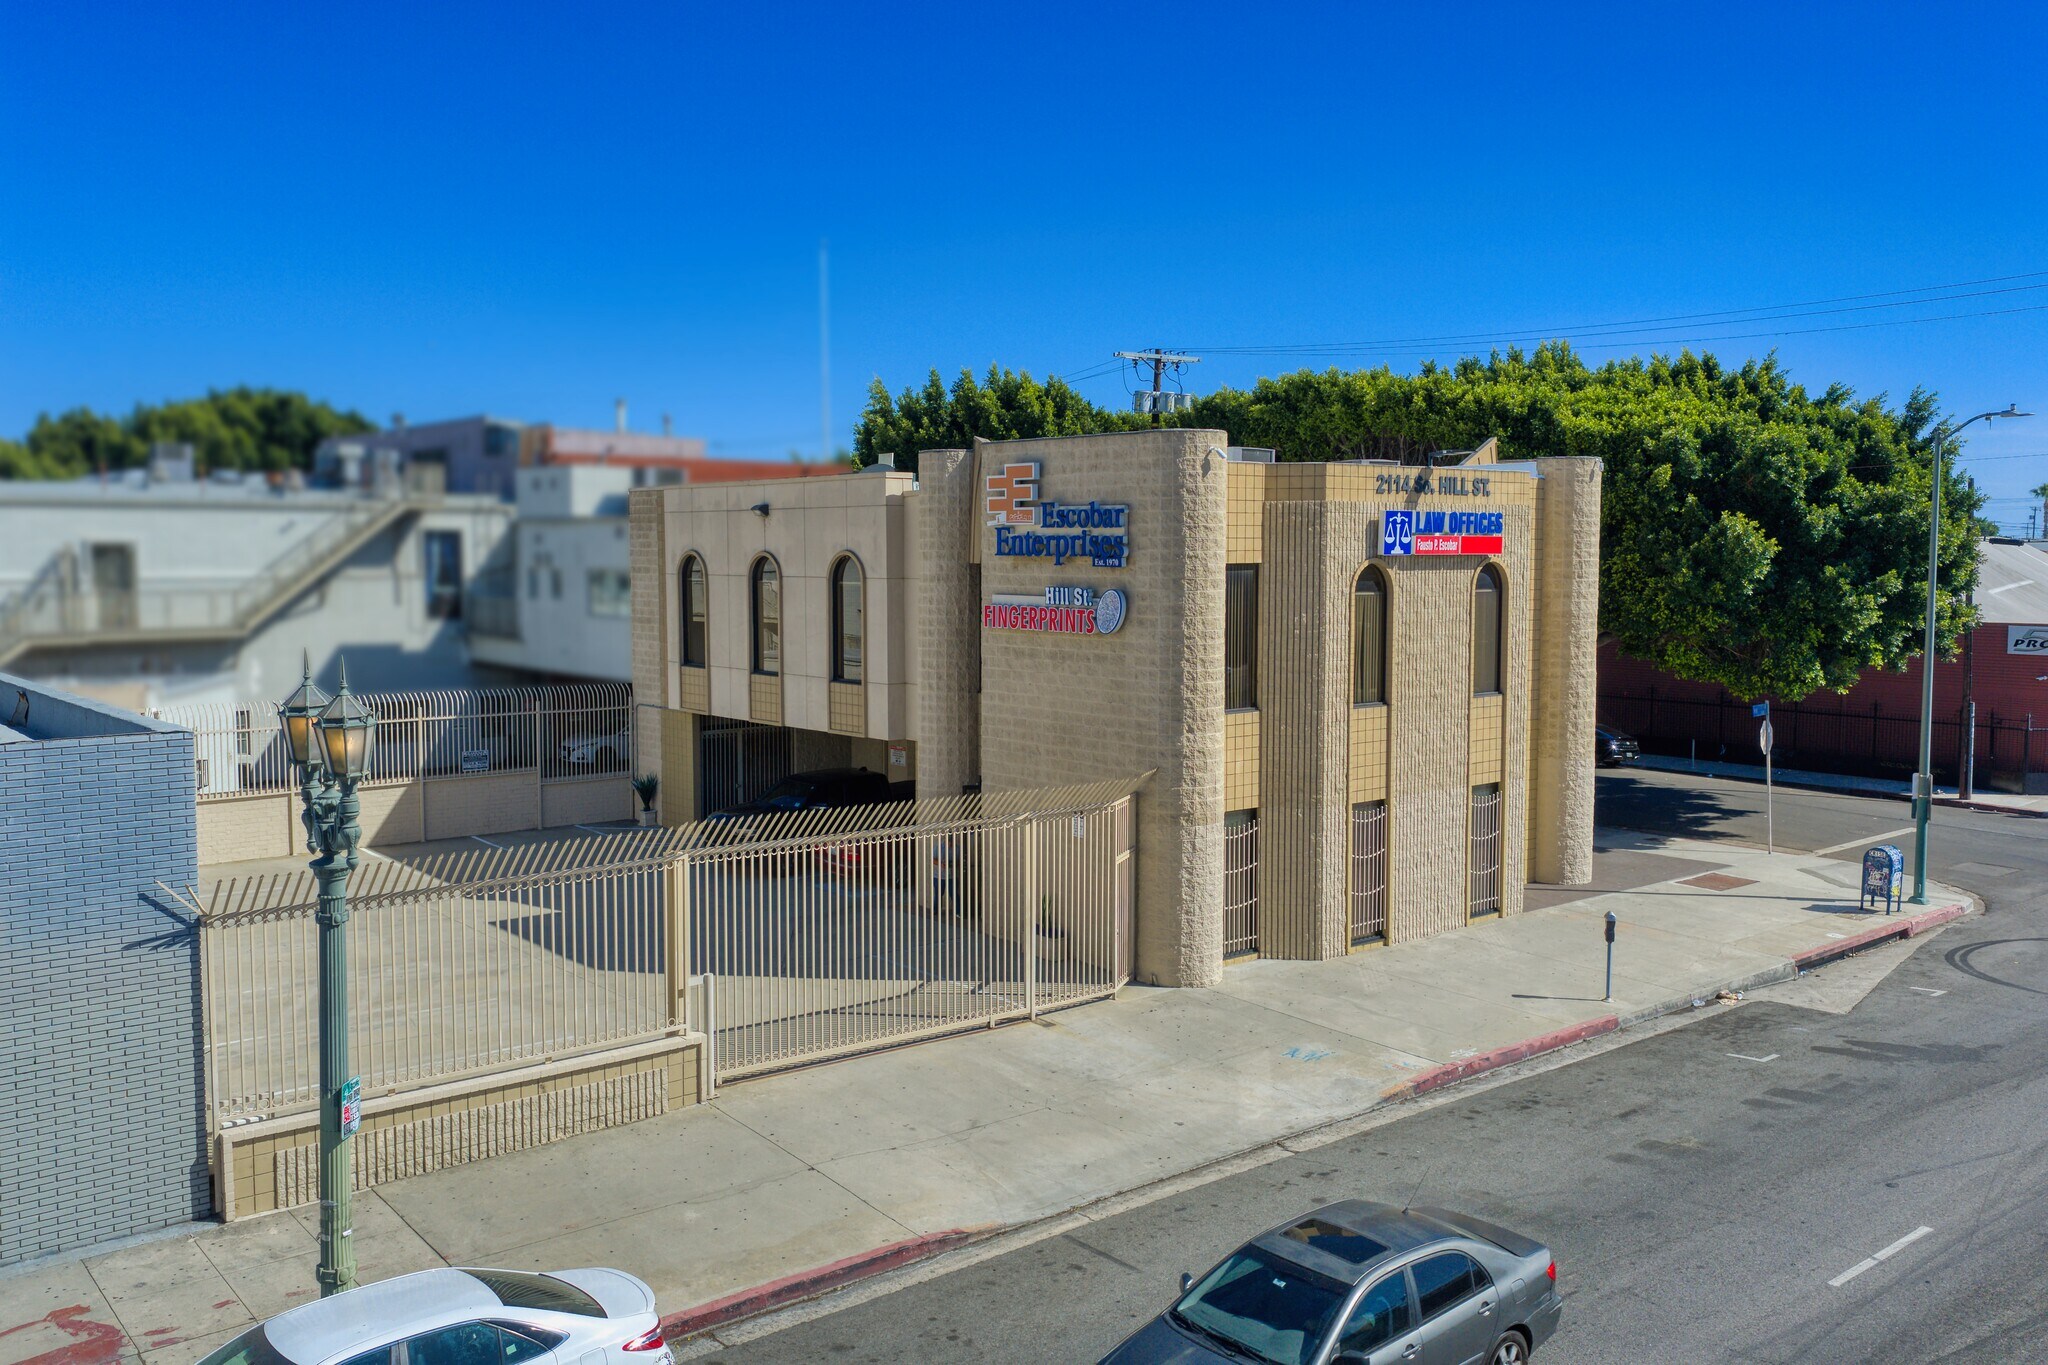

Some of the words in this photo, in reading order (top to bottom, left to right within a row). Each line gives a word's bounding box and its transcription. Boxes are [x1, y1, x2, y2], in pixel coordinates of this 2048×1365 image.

[1376, 474, 1412, 495] 2114
[1413, 475, 1435, 495] So.
[1438, 475, 1469, 497] HILL
[1472, 478, 1491, 498] ST.
[1041, 501, 1125, 529] Escobar
[1415, 511, 1446, 534] LAW
[1449, 512, 1503, 534] OFFICES
[994, 527, 1125, 566] Enterprises
[1416, 538, 1433, 551] Fausto
[1439, 538, 1458, 551] Escobar
[1106, 558, 1119, 567] 1970
[1045, 586, 1070, 605] Hill
[1073, 588, 1093, 606] St.
[983, 605, 1095, 634] FINGERPRINTS
